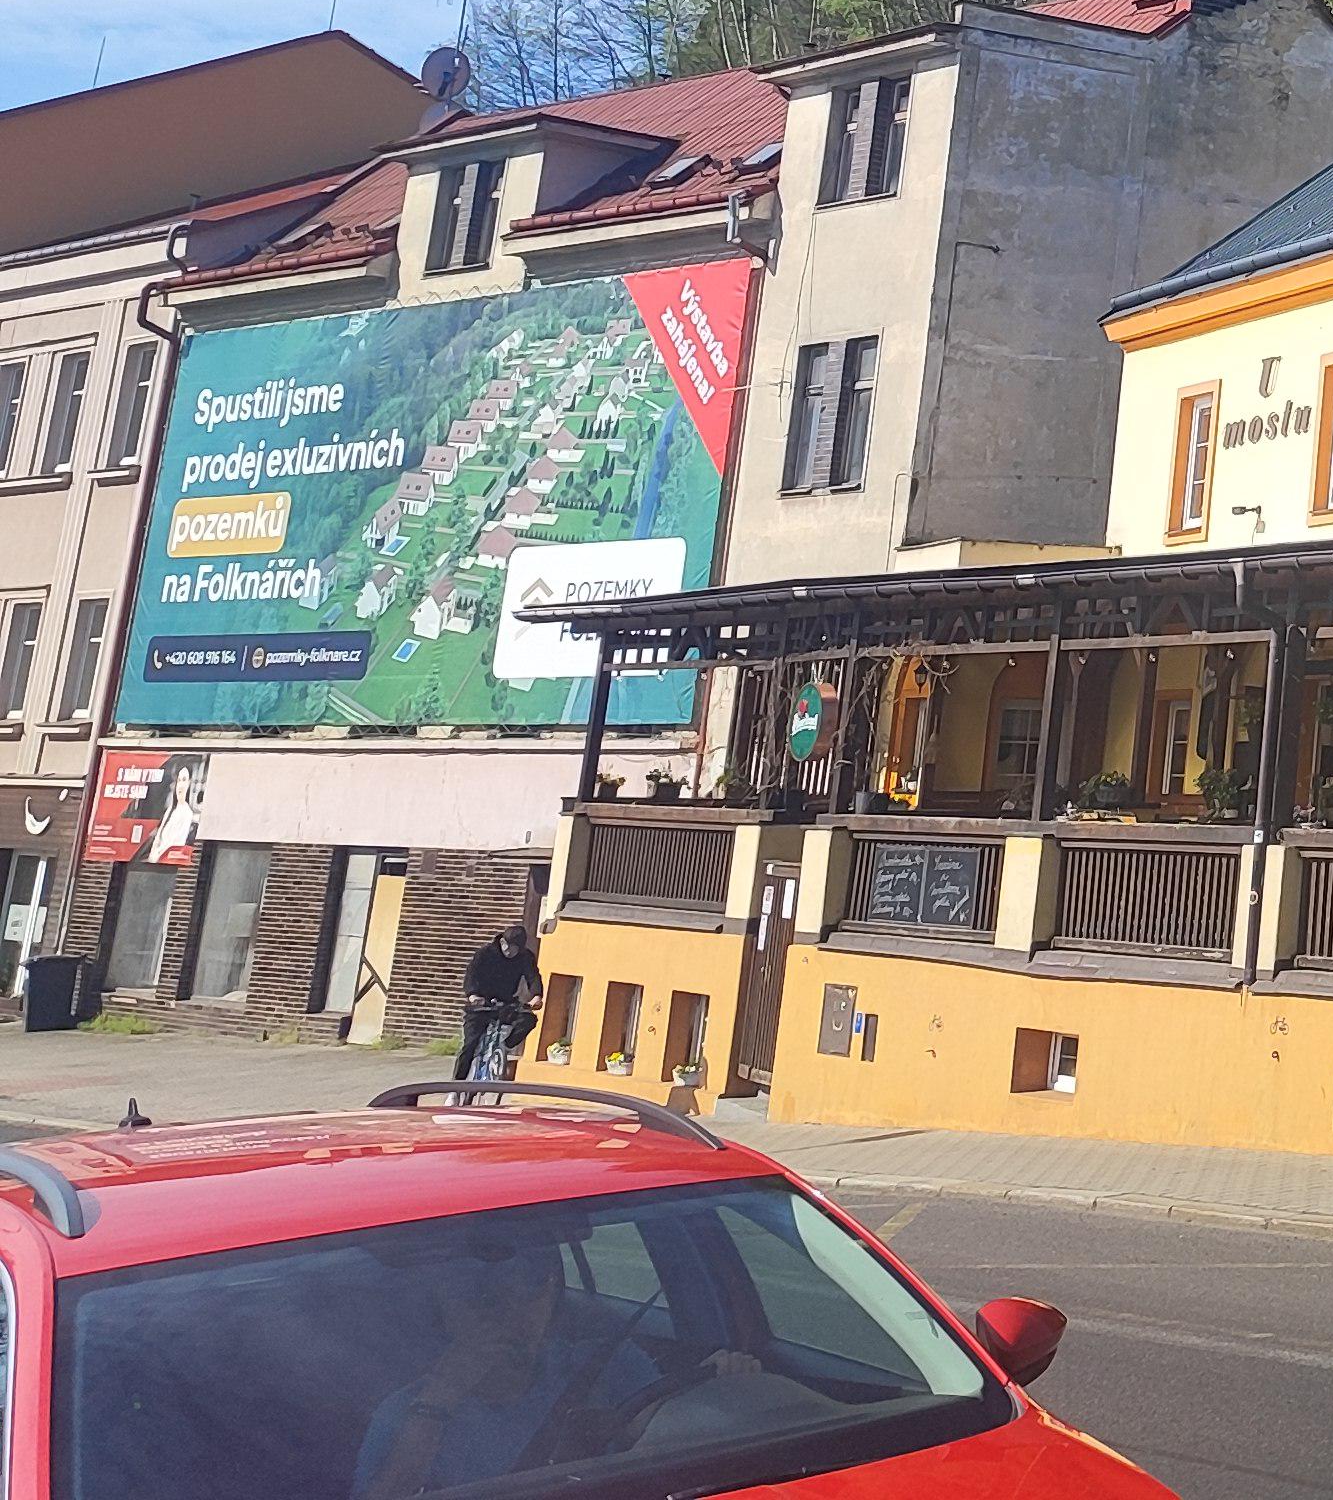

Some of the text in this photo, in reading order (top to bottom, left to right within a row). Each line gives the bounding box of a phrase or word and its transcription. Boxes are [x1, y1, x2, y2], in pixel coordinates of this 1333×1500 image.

[661, 306, 715, 404] zahájena!
[681, 279, 728, 378] Výstavba
[194, 376, 344, 433] Spustili jsme
[1259, 356, 1281, 398] U
[181, 427, 405, 493] prodej exluzivních
[170, 496, 285, 550] pozemků
[161, 559, 322, 603] na Folknářích
[565, 578, 654, 603] POZEMKY
